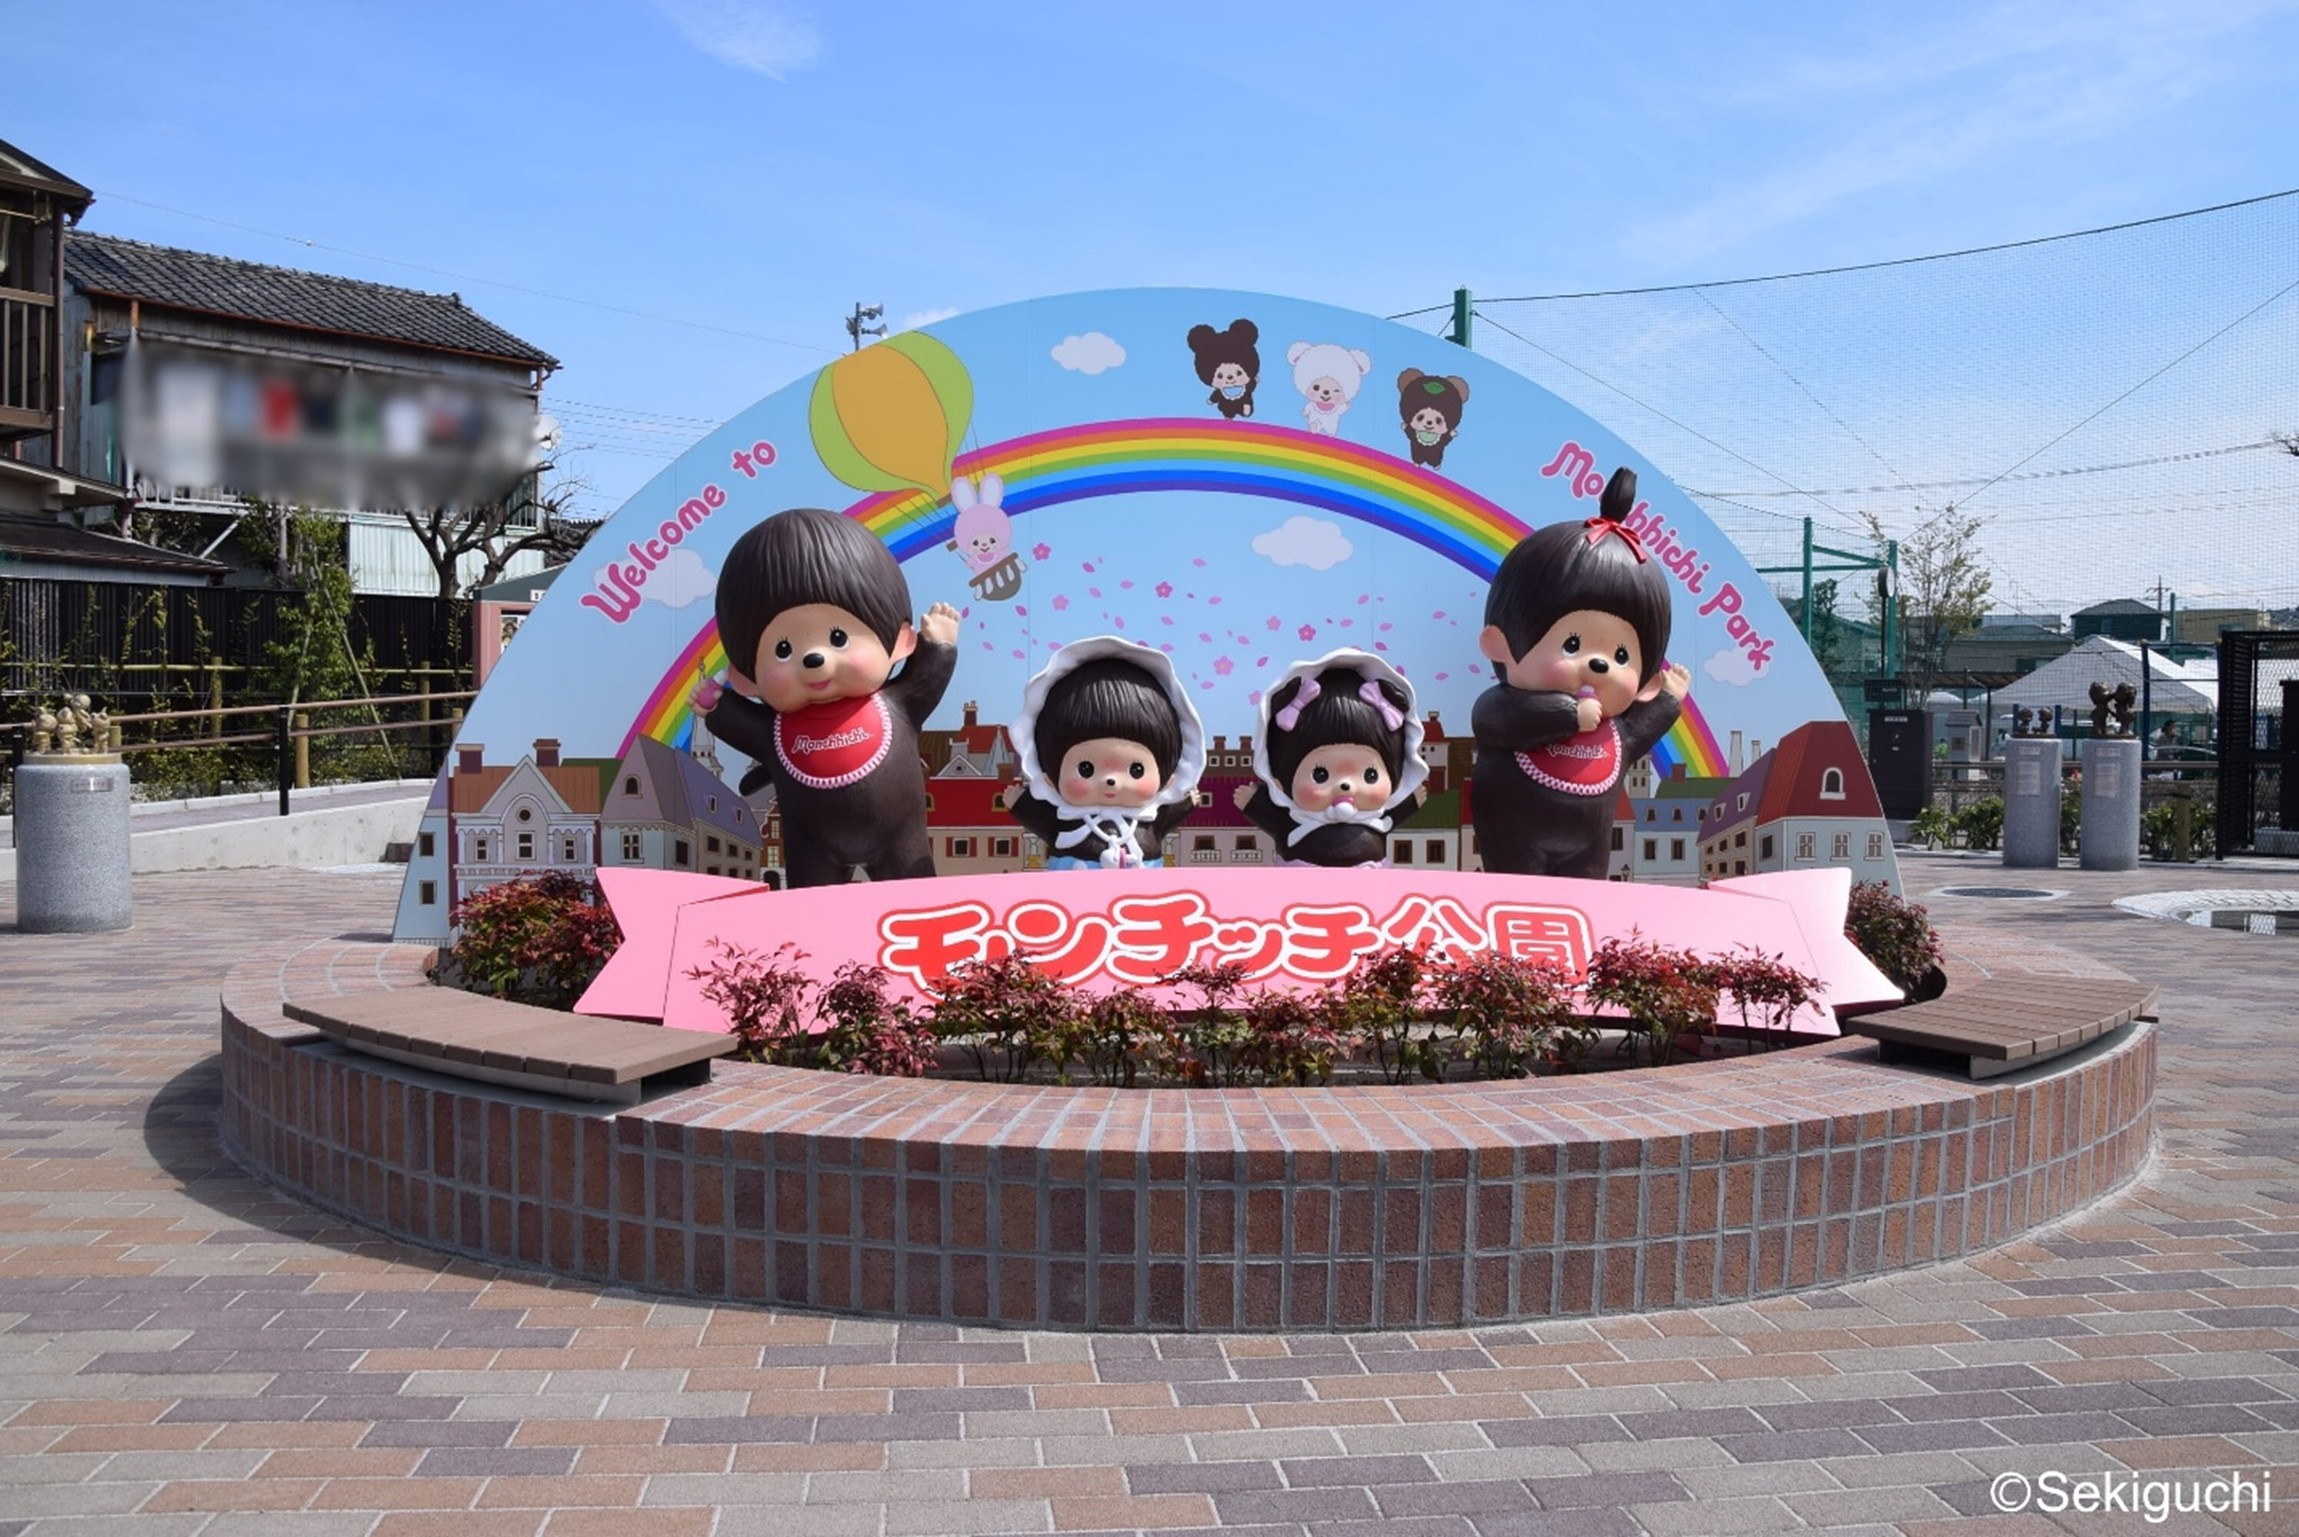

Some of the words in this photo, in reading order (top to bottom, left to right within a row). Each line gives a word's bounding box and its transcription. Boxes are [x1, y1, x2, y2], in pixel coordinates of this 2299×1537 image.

[580, 484, 726, 624] Welcome
[731, 441, 777, 478] to
[1540, 442, 1709, 594] Mohhichi
[1698, 582, 1775, 671] Park
[791, 726, 870, 755] Monchhichi
[877, 889, 1594, 1002] モンチッチ公園
